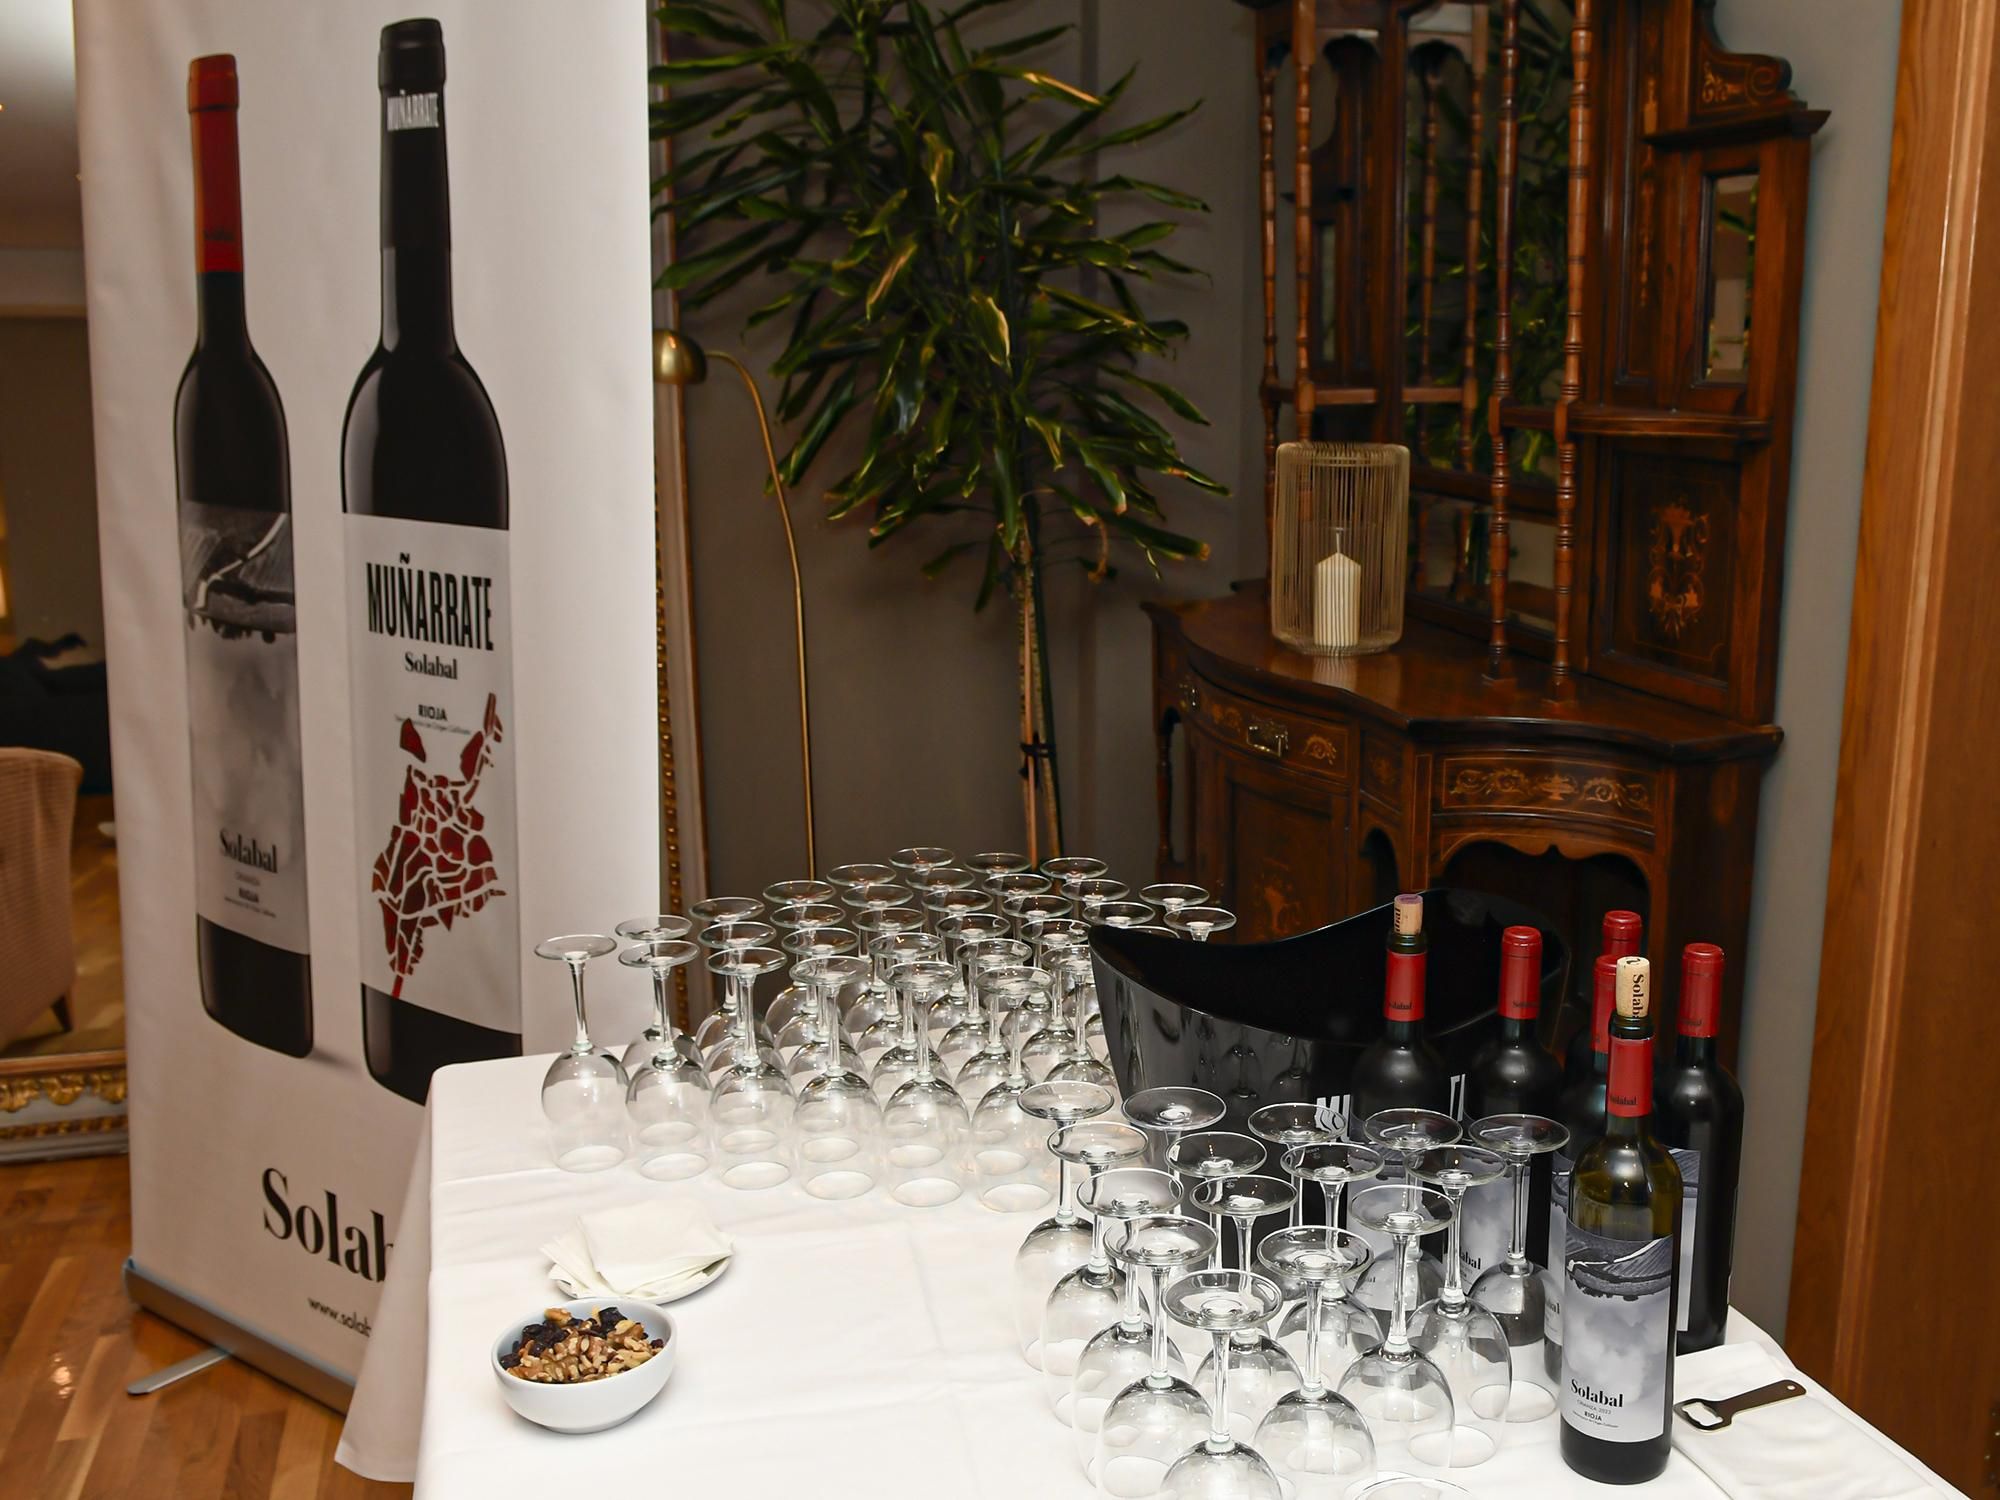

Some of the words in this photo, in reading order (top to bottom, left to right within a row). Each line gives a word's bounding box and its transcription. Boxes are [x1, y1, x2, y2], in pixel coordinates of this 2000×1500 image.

[366, 552, 494, 651] MUÑARRATE
[404, 651, 458, 680] Solabal
[418, 704, 448, 721] RIOJA
[1571, 1379, 1624, 1408] Solabal
[1584, 1411, 1602, 1421] RIOJA
